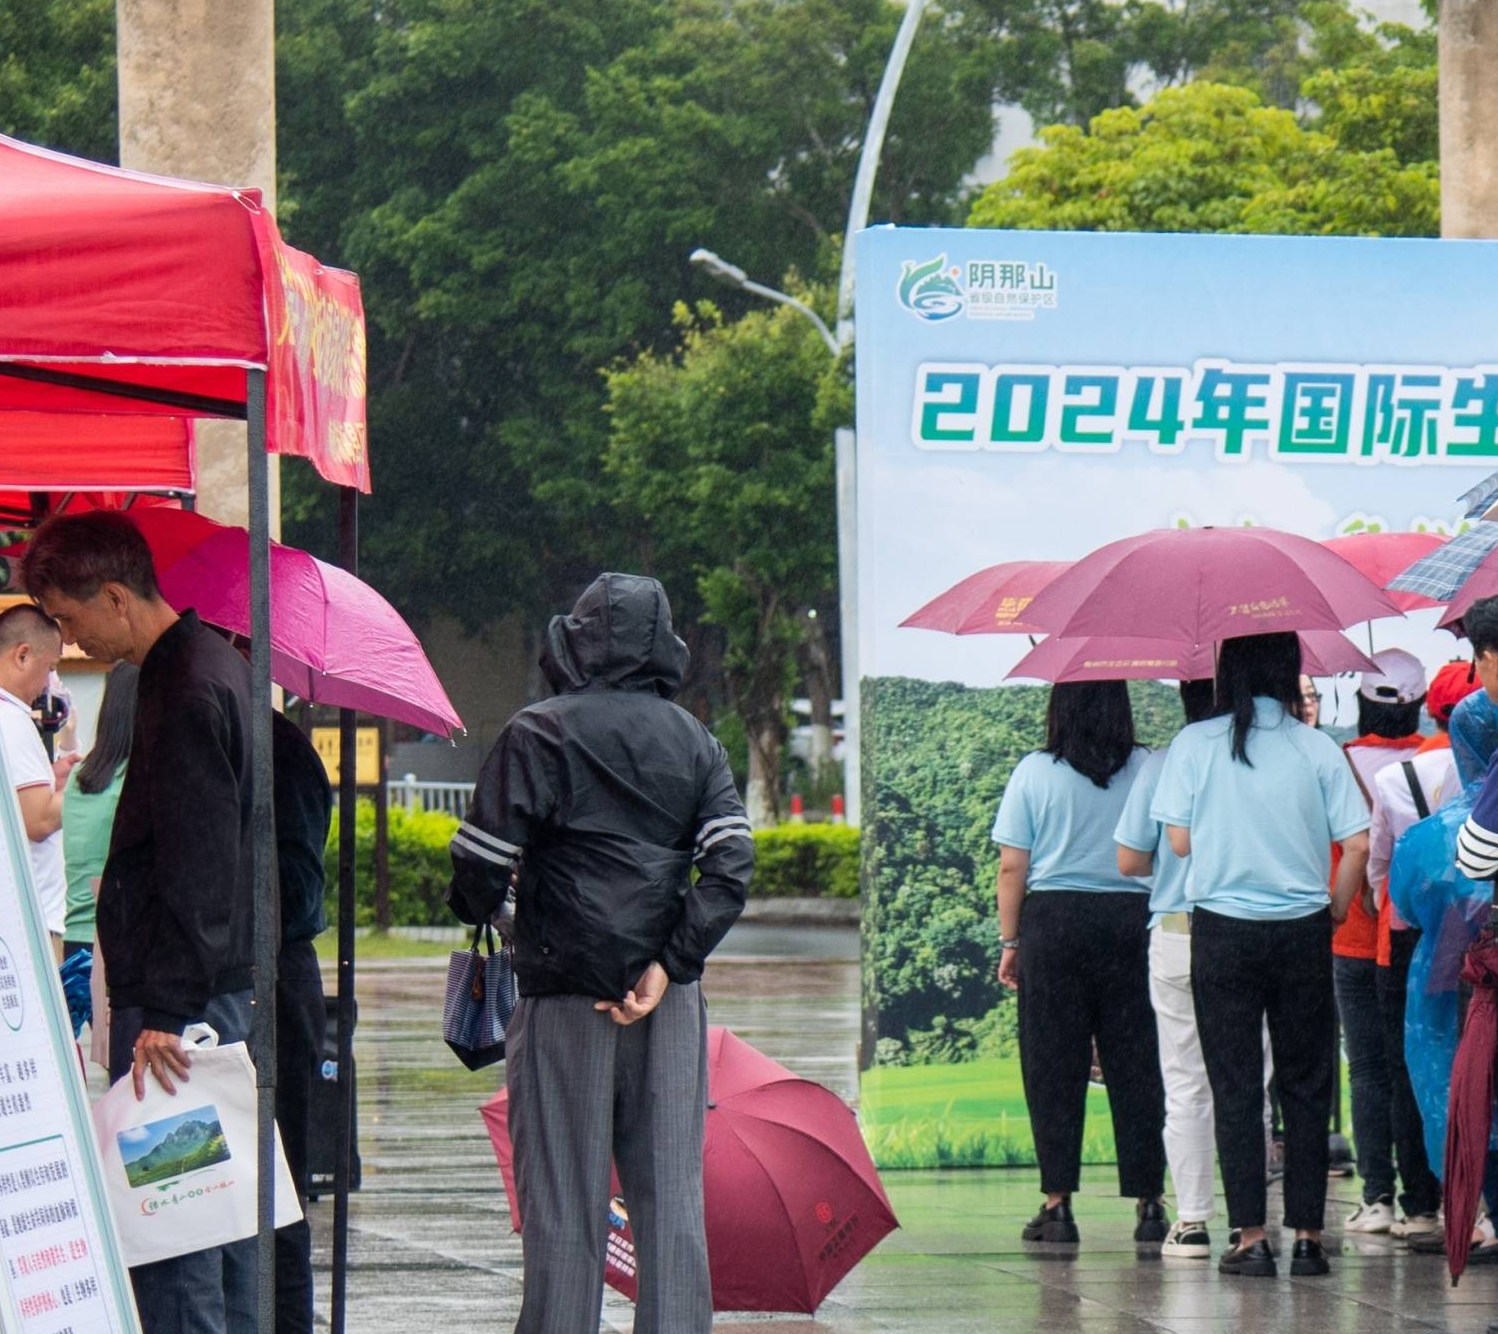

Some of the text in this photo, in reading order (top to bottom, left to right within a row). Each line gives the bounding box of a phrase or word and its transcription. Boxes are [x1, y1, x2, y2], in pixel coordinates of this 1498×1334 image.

[969, 262, 1055, 289] 阴那山
[969, 290, 1056, 305] 省级自然保护区
